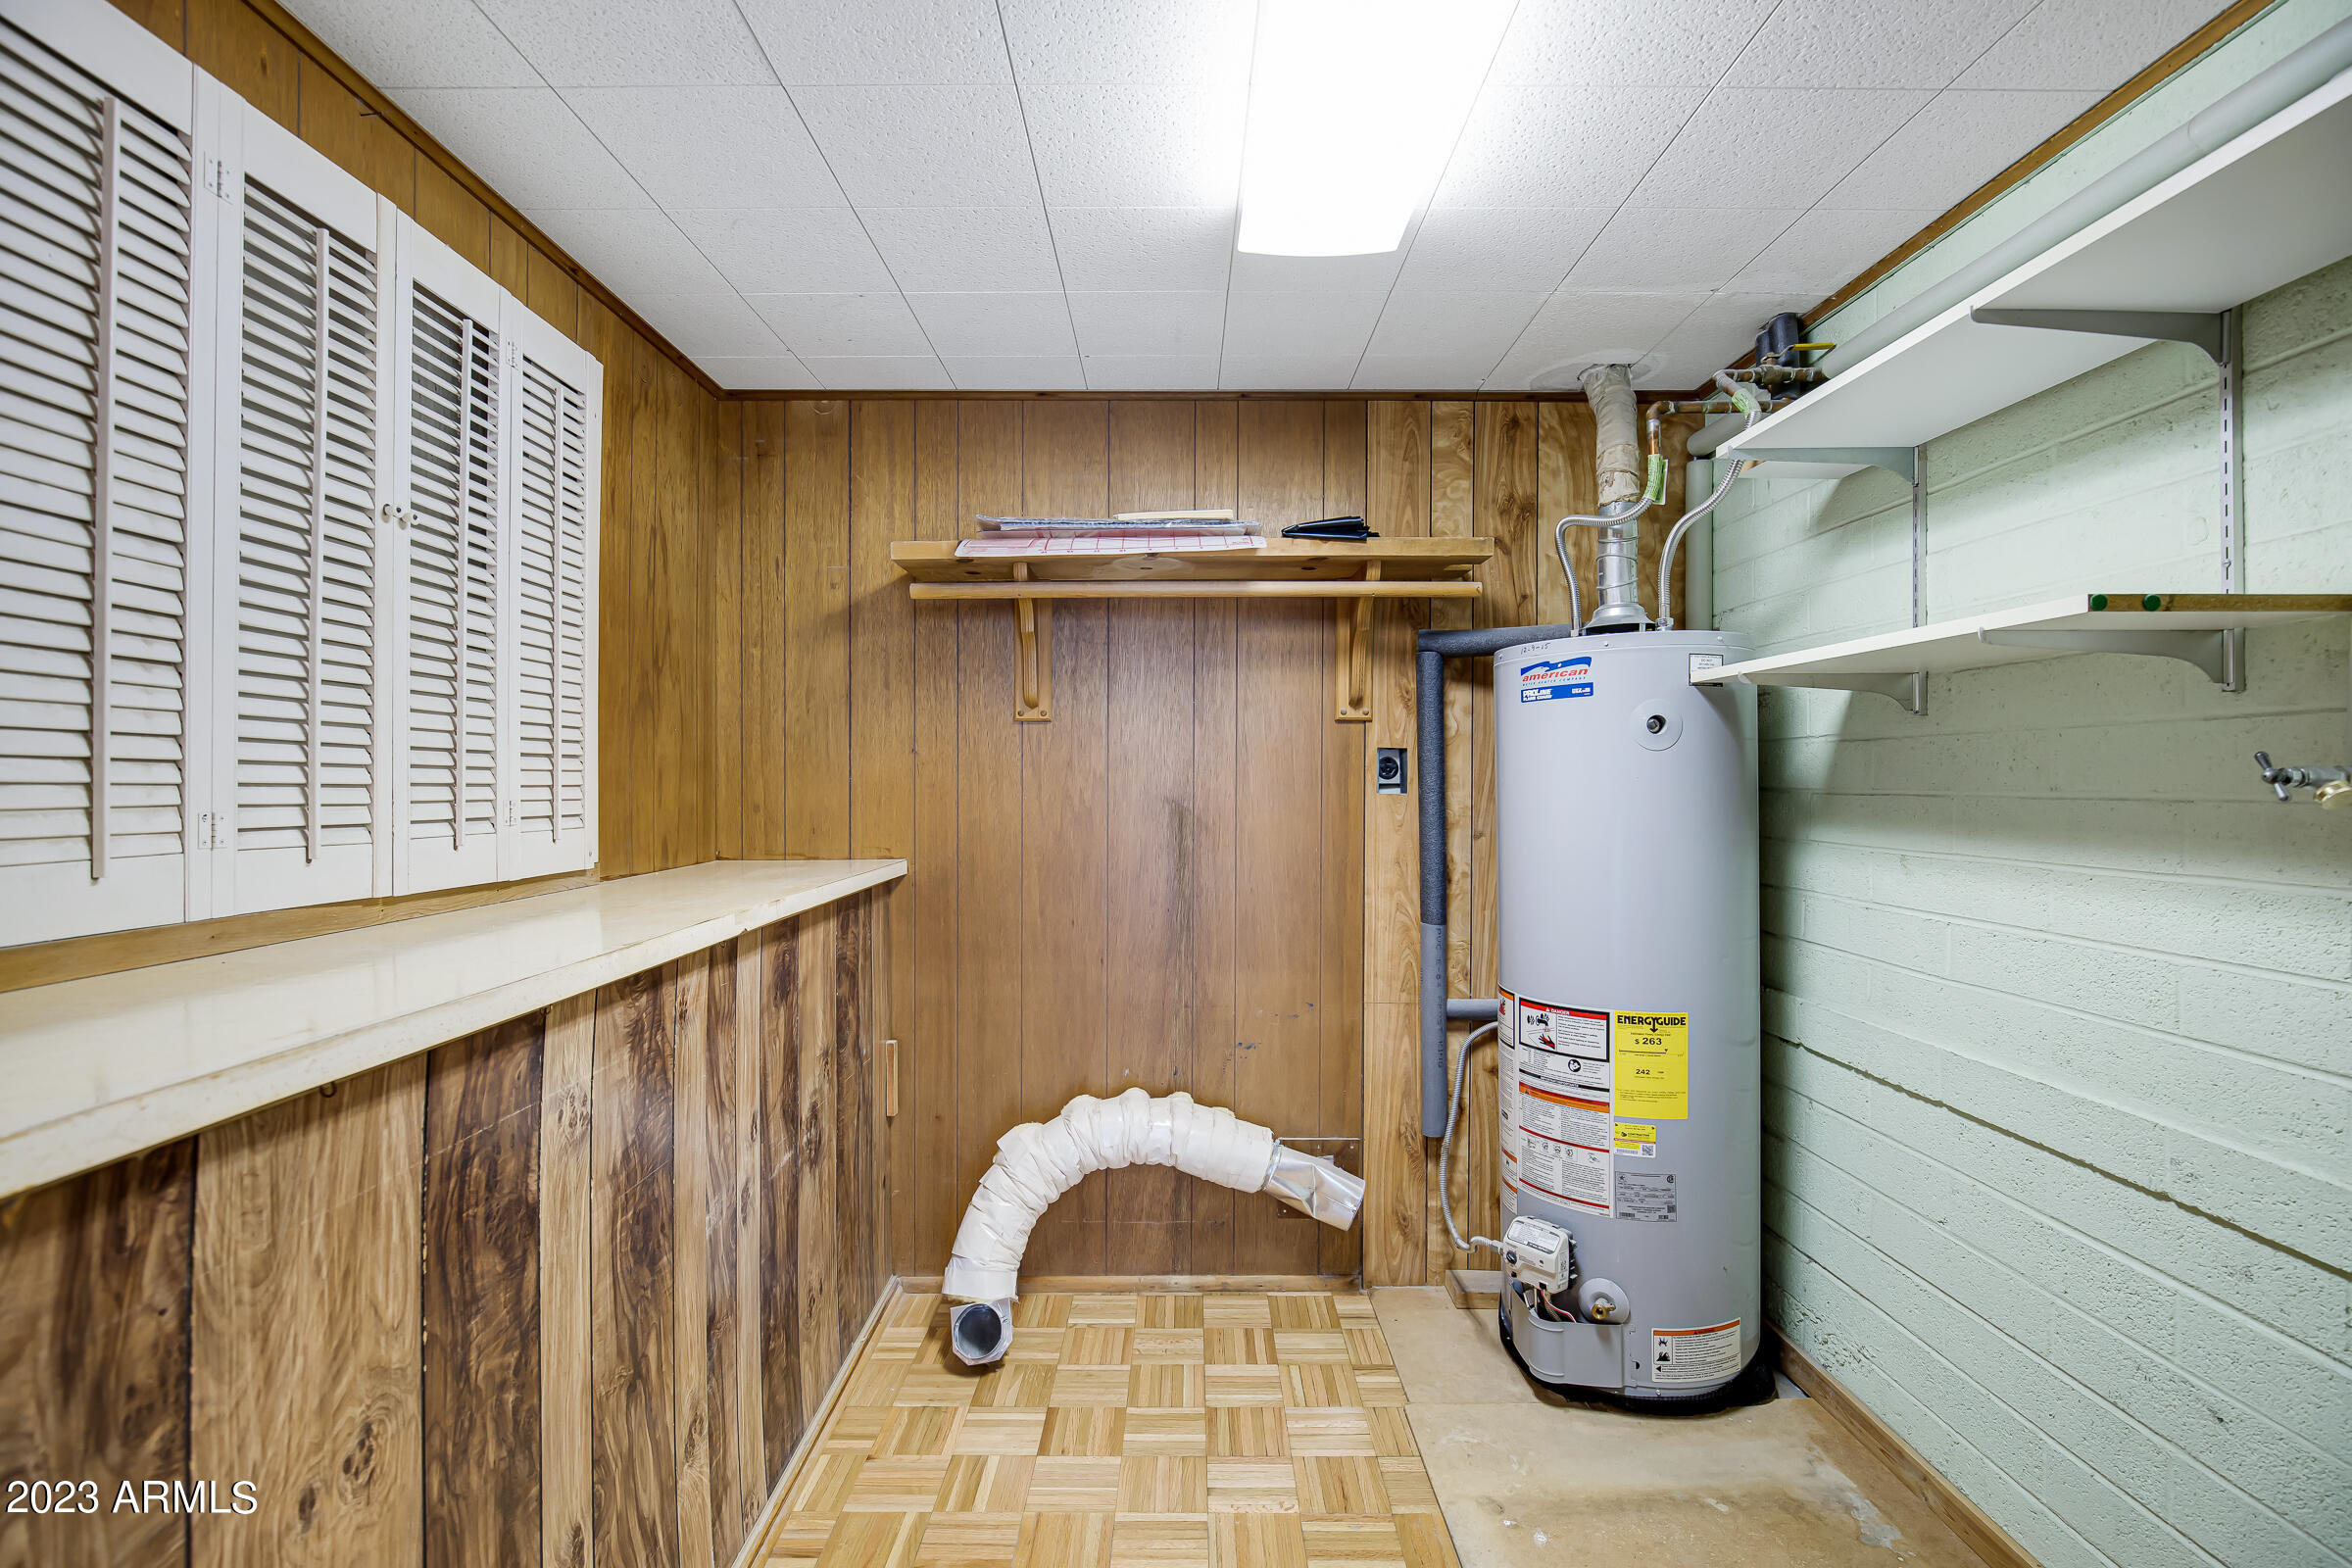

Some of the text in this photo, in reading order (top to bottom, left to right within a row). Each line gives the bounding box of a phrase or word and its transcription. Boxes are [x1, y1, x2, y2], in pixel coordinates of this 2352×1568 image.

[1522, 668, 1589, 682] american
[1617, 1015, 1687, 1027] ENERGYGUIDE
[1642, 1037, 1662, 1046] 263
